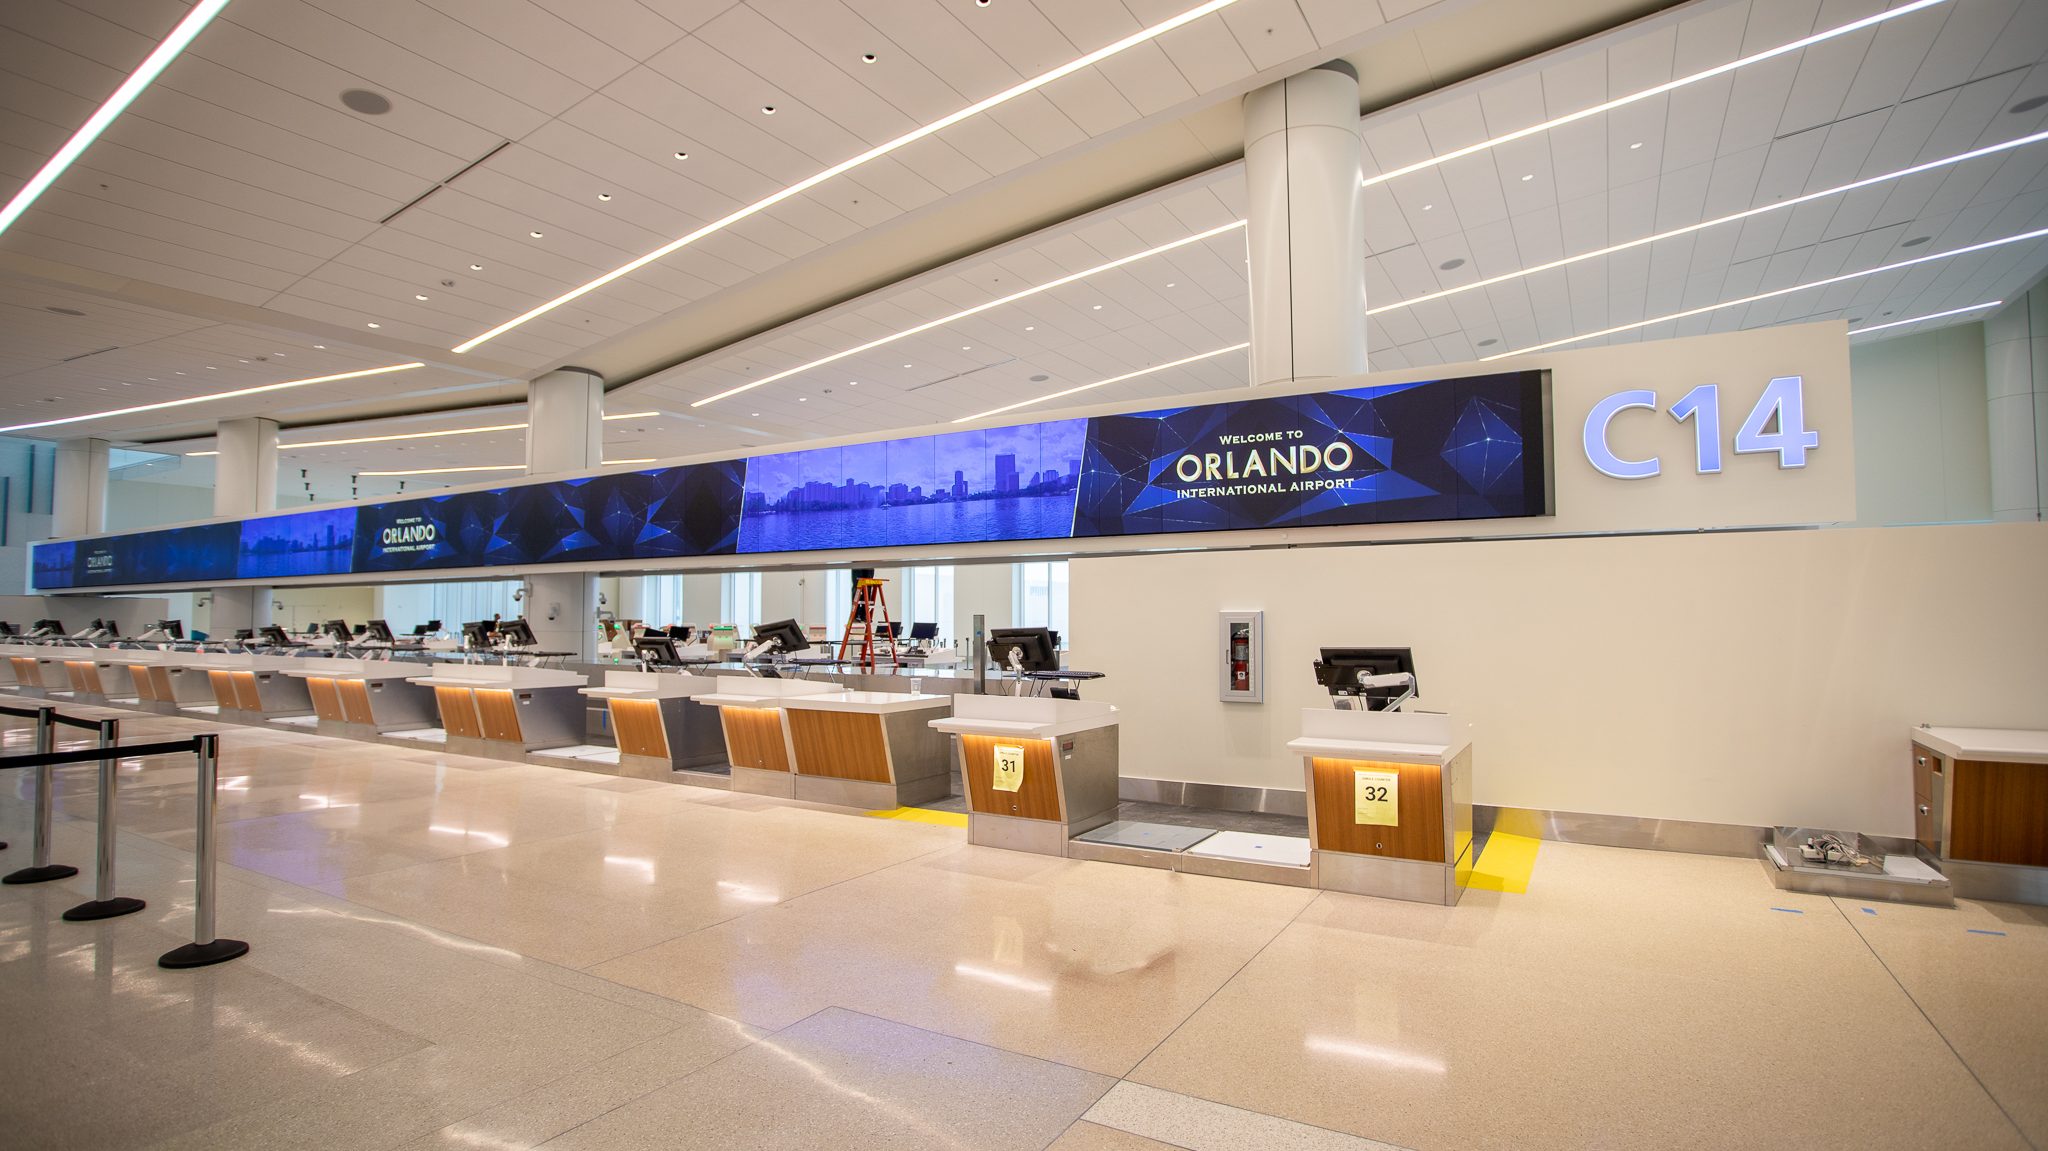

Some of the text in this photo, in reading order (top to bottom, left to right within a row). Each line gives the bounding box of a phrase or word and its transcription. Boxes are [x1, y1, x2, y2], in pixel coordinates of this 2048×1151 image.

[1583, 375, 1819, 480] C14
[1219, 430, 1303, 446] WELCOME TO
[1176, 441, 1353, 482] ORLANDO
[1177, 478, 1354, 499] INTERNATIONAL AIRPORT
[383, 524, 435, 544] ORLANDO
[1002, 758, 1015, 773] 31
[1365, 786, 1388, 802] 32
